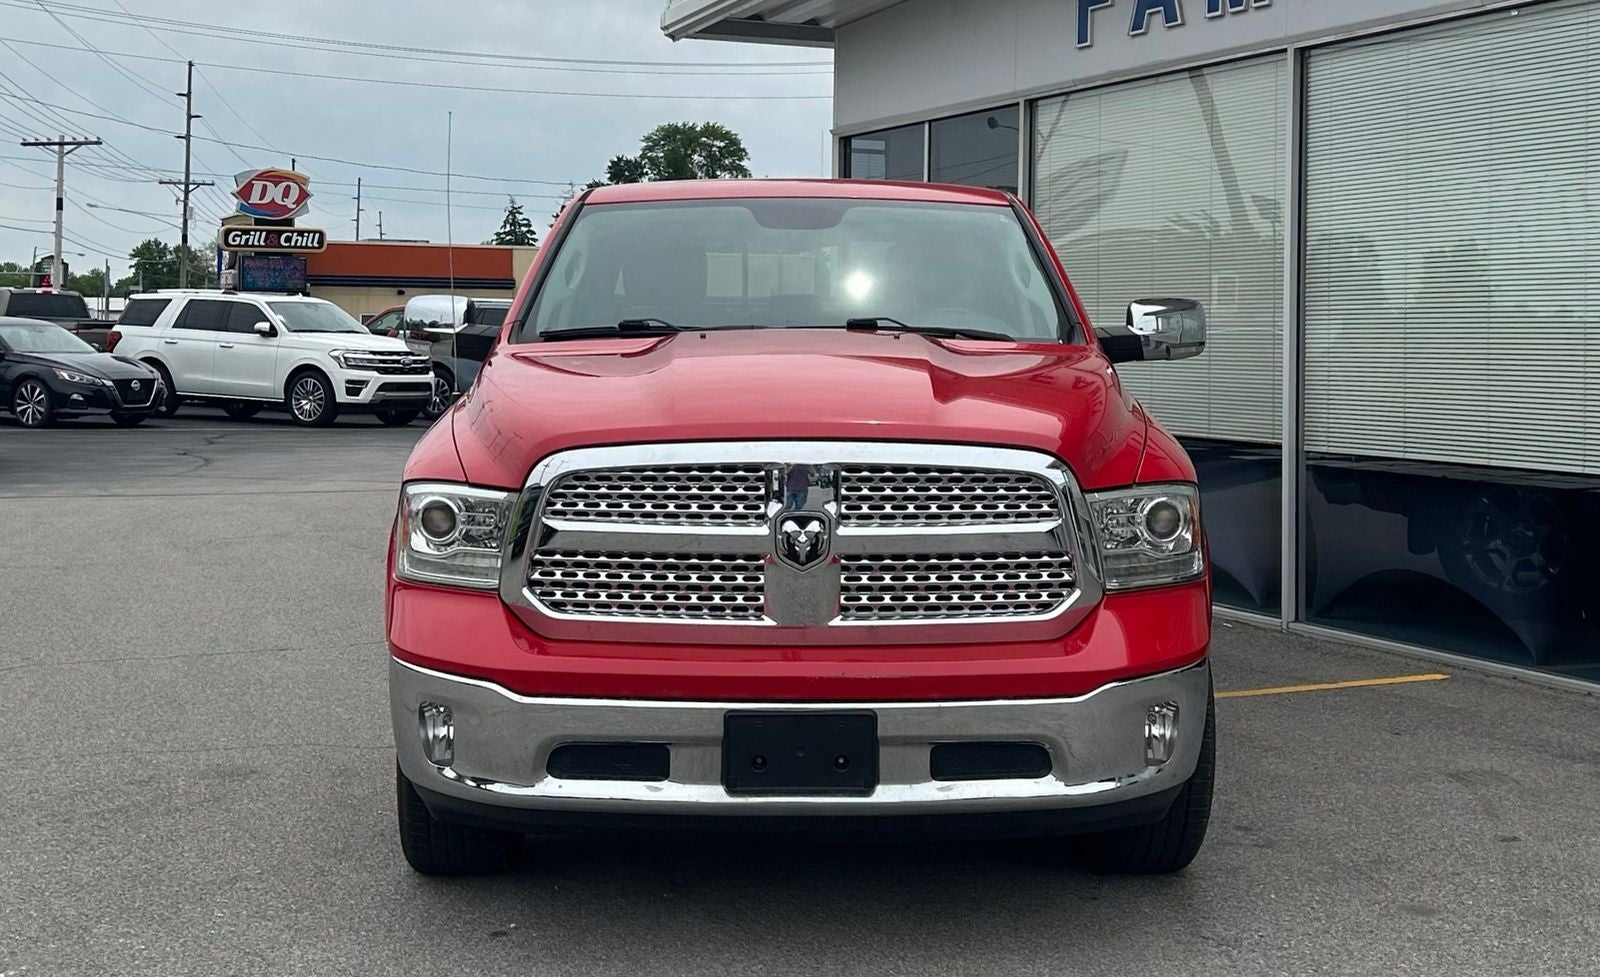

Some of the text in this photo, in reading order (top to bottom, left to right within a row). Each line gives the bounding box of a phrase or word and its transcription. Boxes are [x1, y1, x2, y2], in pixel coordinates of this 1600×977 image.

[248, 180, 300, 209] DQ
[228, 231, 267, 246] Grill
[280, 232, 320, 247] Chill
